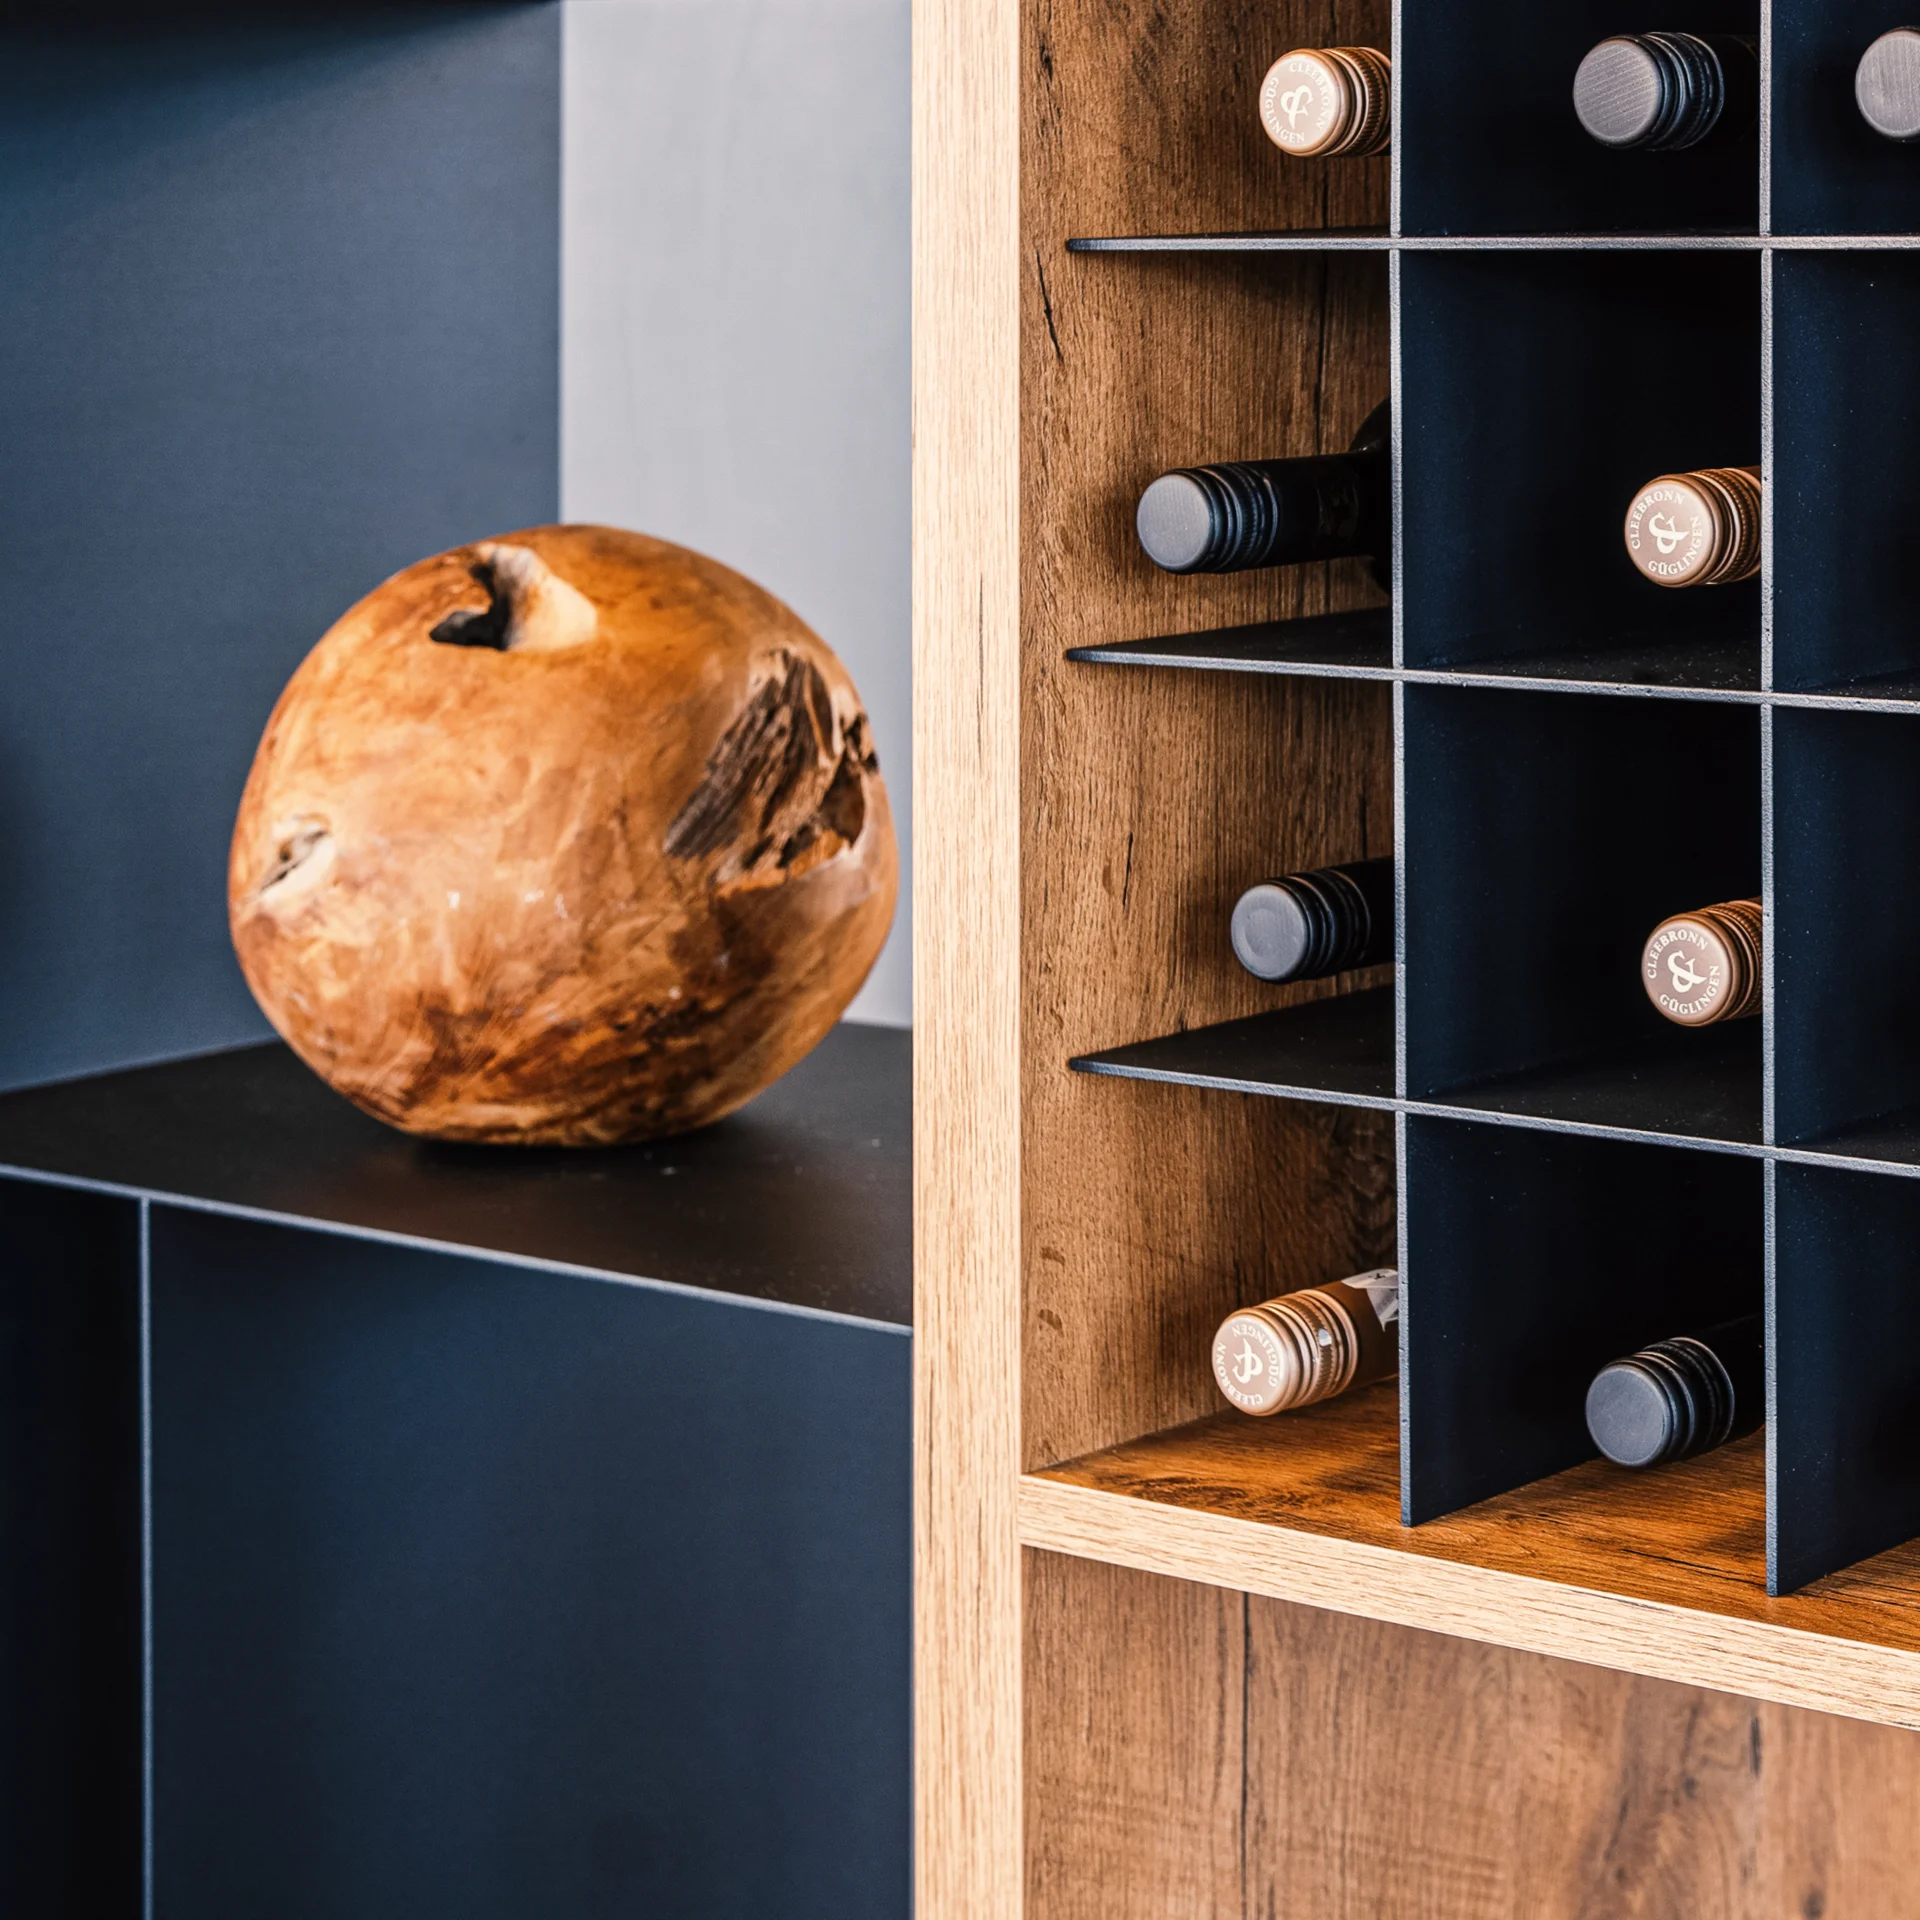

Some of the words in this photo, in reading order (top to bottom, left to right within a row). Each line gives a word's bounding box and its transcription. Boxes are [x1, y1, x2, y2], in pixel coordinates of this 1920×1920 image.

[1280, 84, 1315, 130] &
[1630, 489, 1685, 550] CLEEBRONN
[1648, 511, 1691, 554] &
[1648, 516, 1703, 576] GÜGLINGEN
[1647, 928, 1708, 979] CLEEBRONN
[1667, 950, 1707, 993] &
[1659, 965, 1720, 1014] GÜGLINGEN
[1216, 1342, 1264, 1406] CLEEBRONN
[1232, 1337, 1264, 1384] &
